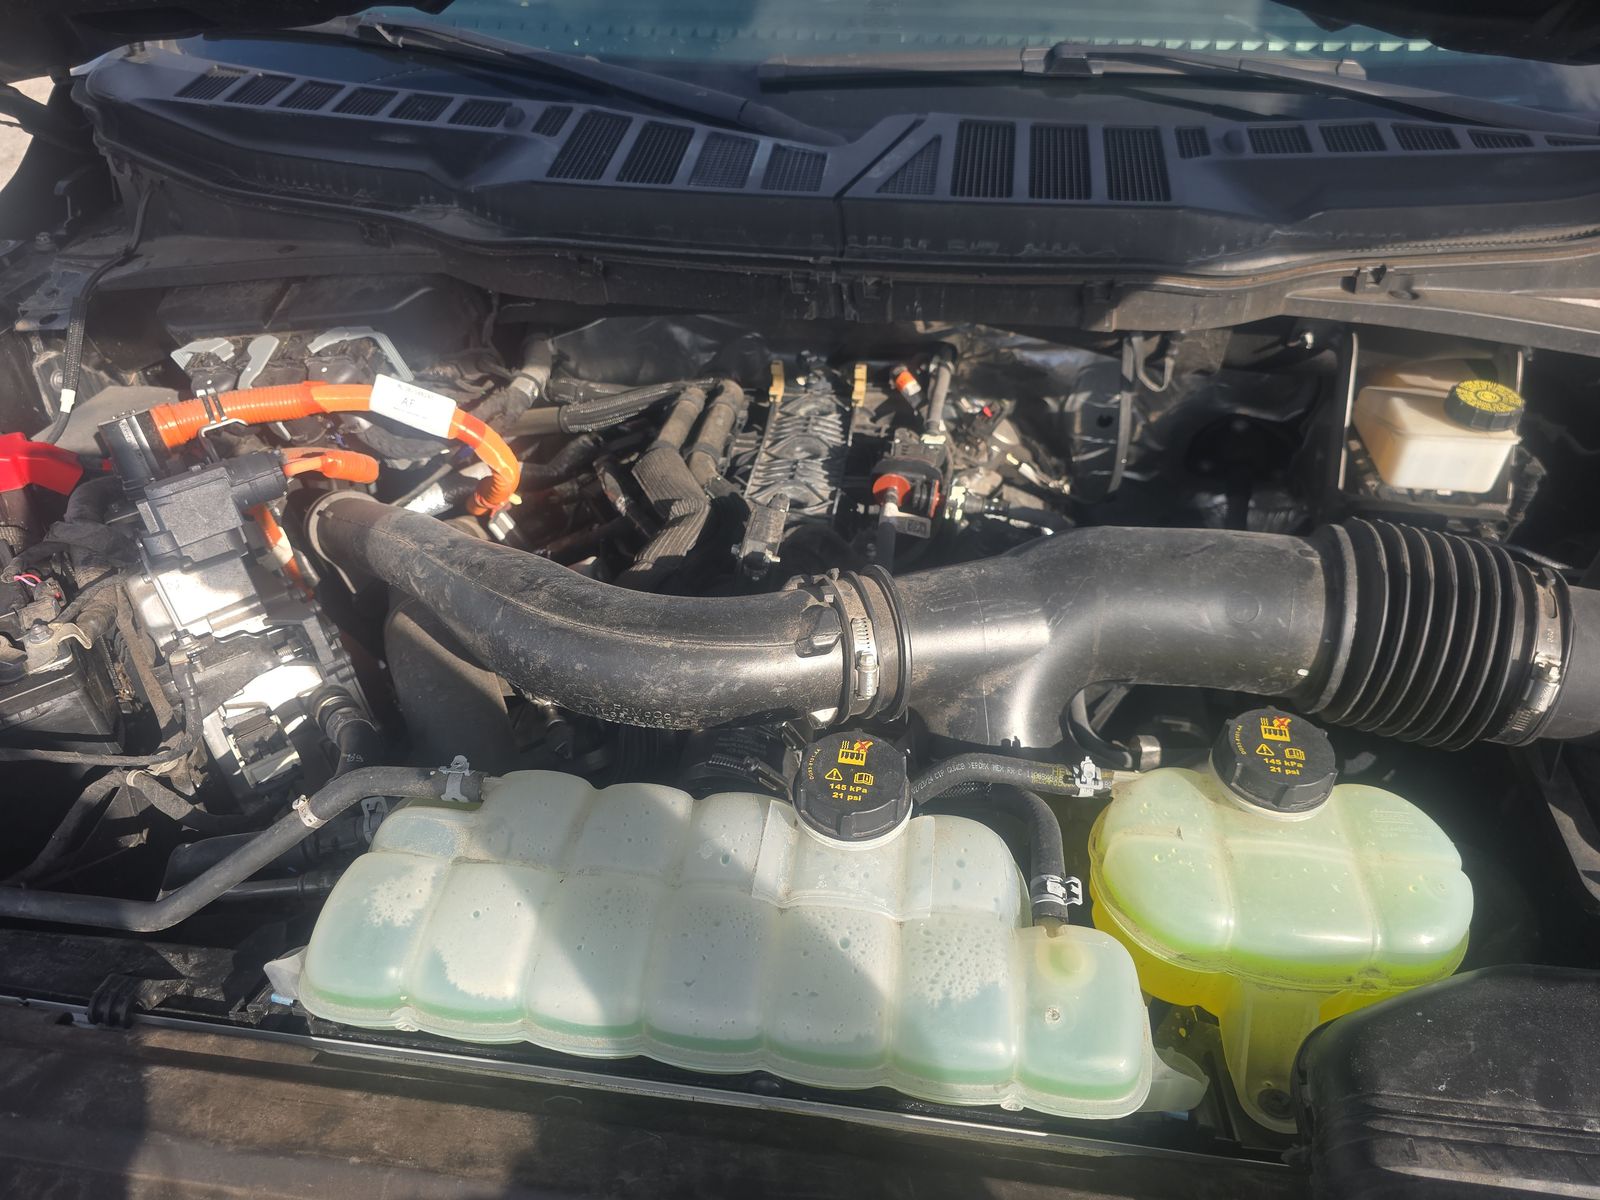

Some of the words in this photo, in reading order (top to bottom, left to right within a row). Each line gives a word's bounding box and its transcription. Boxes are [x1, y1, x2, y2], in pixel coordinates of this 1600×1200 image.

[1284, 759, 1304, 768] kPa
[1285, 768, 1300, 776] psi
[829, 783, 847, 791] 145
[849, 785, 869, 794] kPa
[832, 791, 844, 800] 21
